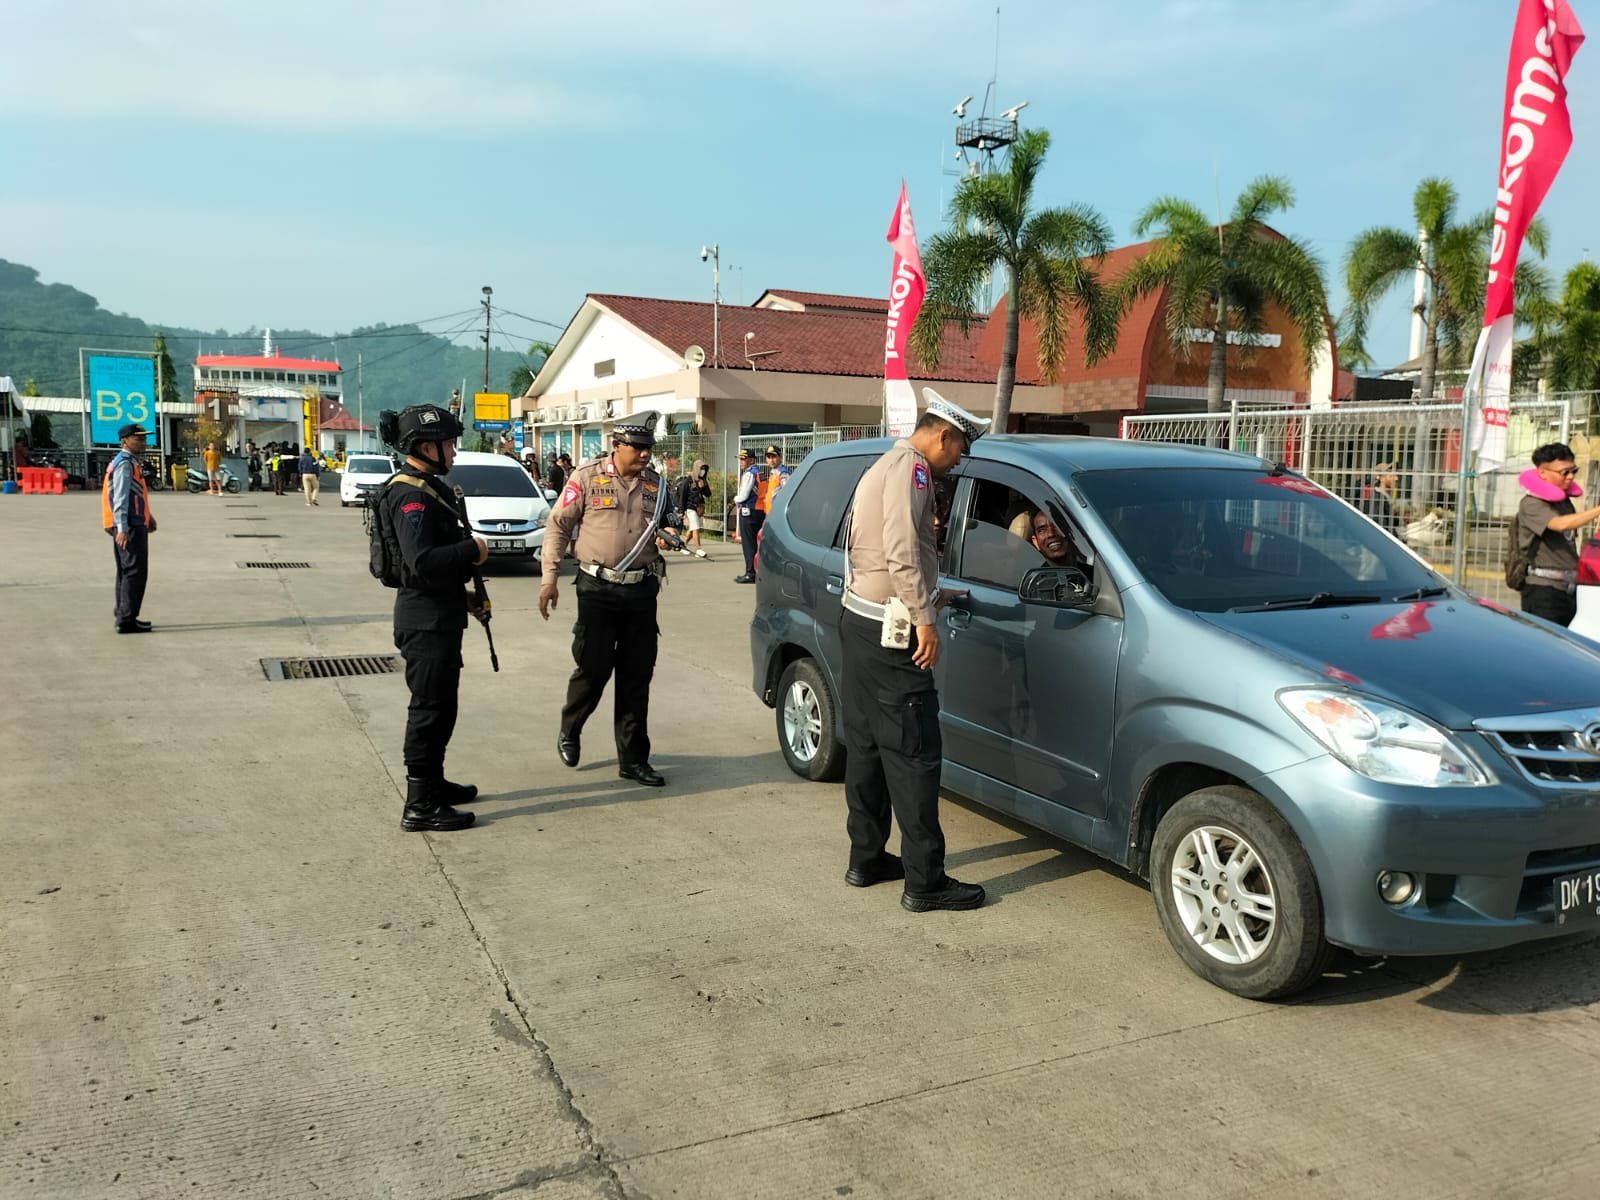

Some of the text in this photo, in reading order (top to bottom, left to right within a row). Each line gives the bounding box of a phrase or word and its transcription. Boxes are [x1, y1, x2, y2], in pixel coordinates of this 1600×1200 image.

[96, 389, 149, 423] B3
[208, 398, 220, 420] 1
[1560, 877, 1581, 911] DK
